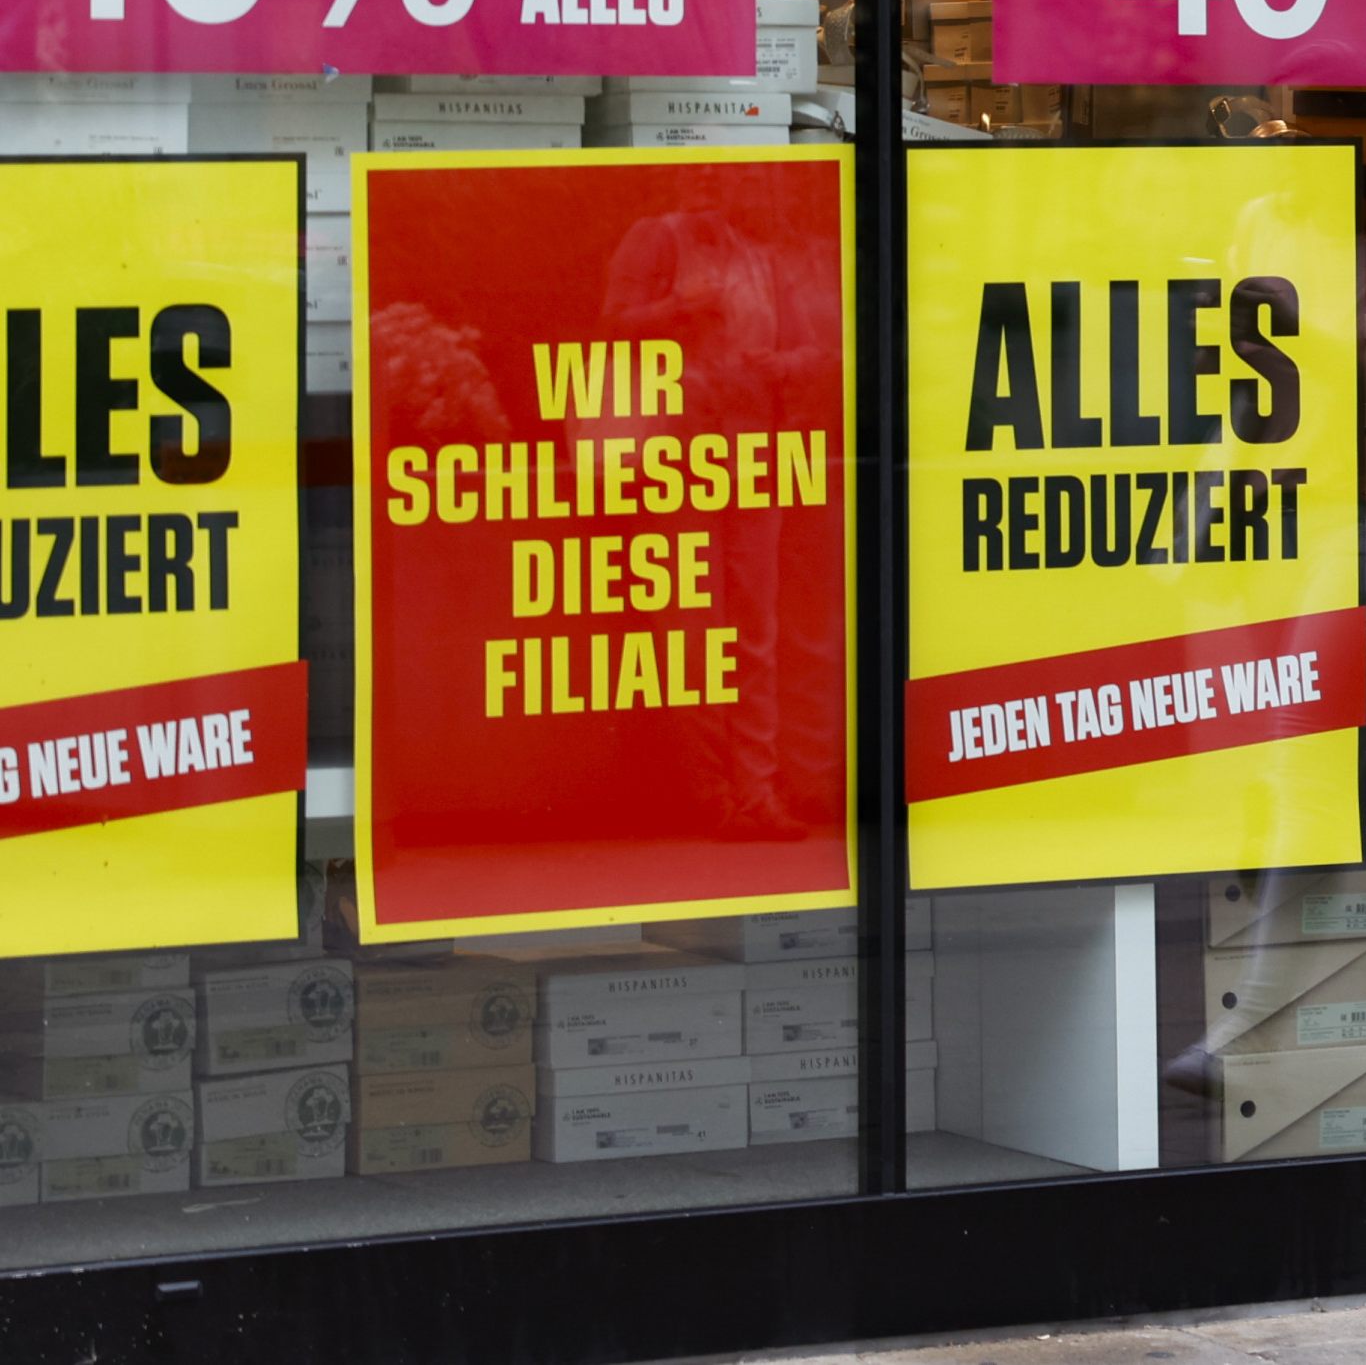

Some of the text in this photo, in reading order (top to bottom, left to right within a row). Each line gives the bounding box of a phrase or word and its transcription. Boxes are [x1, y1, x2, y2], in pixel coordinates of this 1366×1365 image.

[439, 102, 523, 115] HISPANITAS
[534, 340, 683, 419] WIR
[966, 277, 1300, 451] ALLES
[388, 431, 826, 525] SCHLIESSEN
[963, 468, 1306, 571] REDUZIERT
[513, 532, 711, 617] DIESE
[486, 628, 738, 717] FILIALE
[950, 651, 1320, 761] JEDEN TAG NEUE WARE
[28, 730, 130, 797] NEUE
[137, 710, 253, 778] WARE
[609, 977, 688, 993] HISPANITAS
[615, 1070, 694, 1085] HISPANITAS
